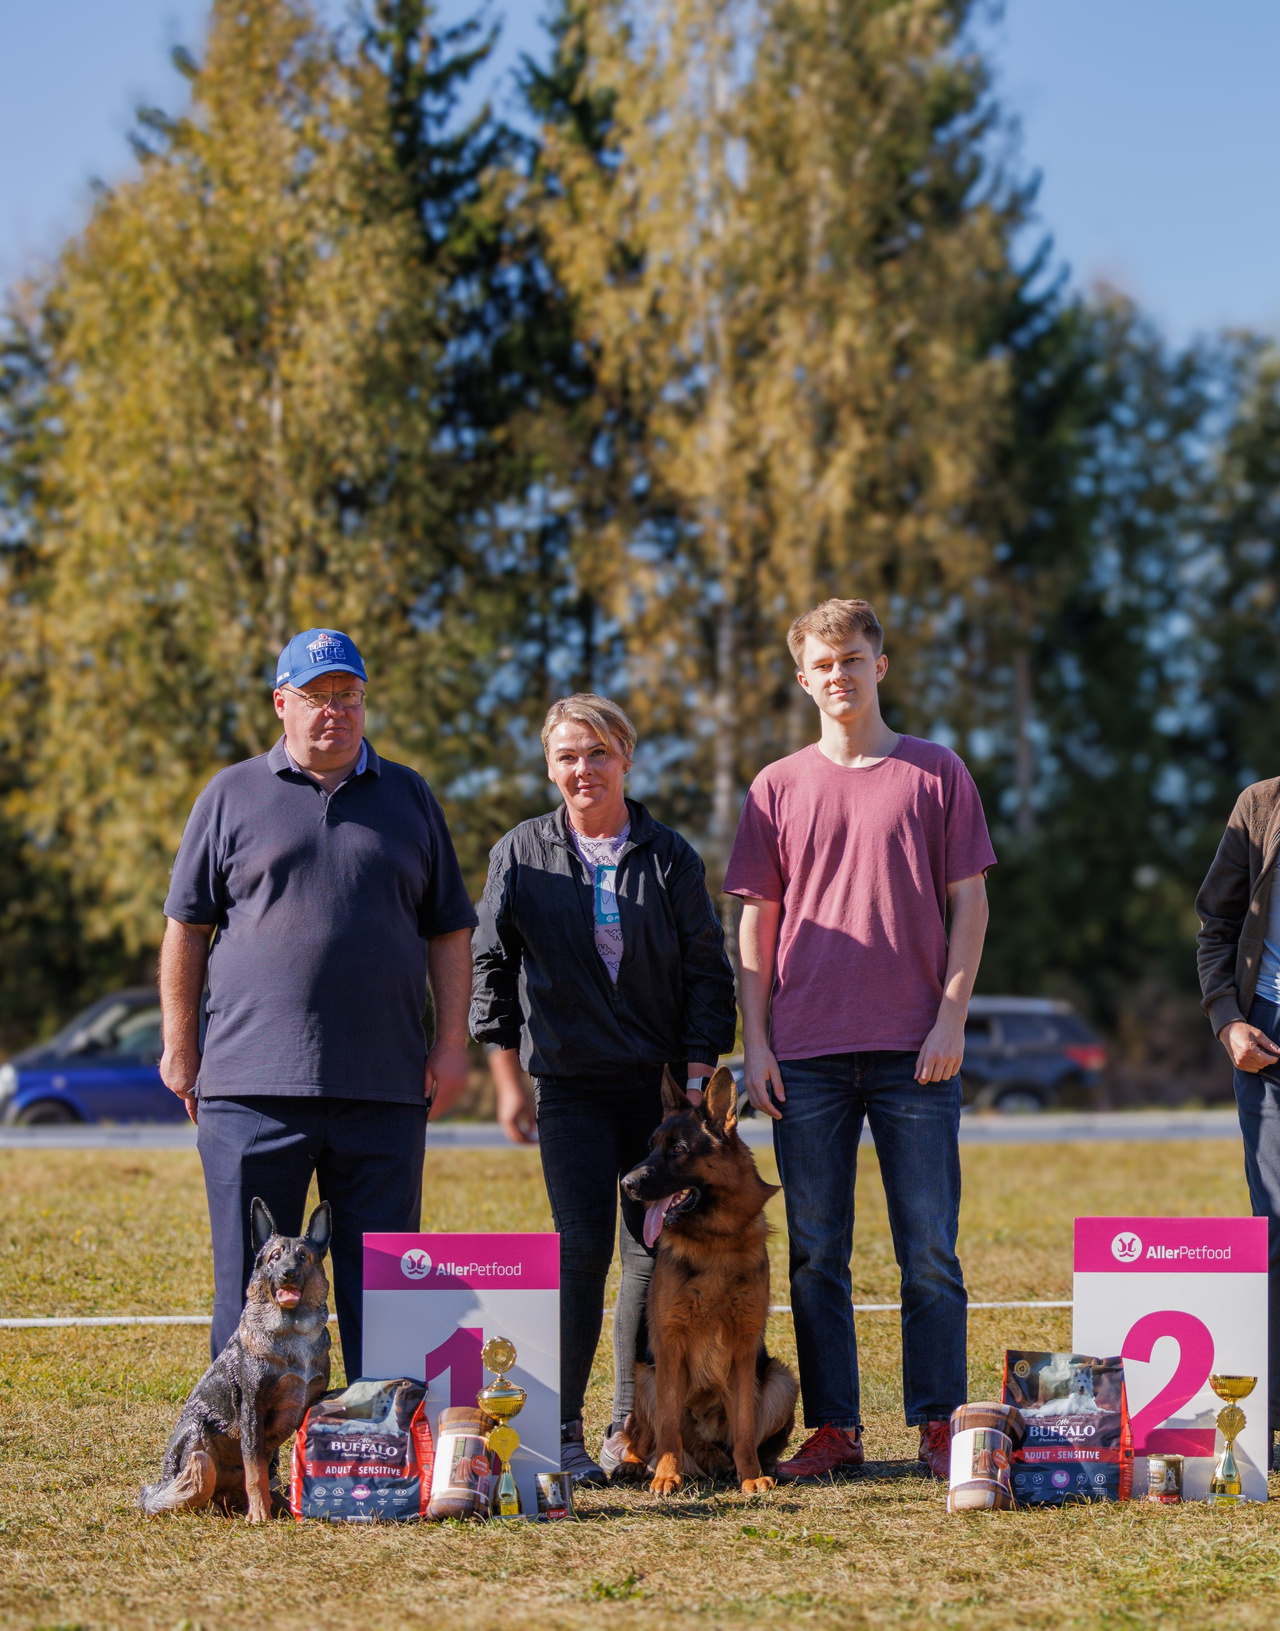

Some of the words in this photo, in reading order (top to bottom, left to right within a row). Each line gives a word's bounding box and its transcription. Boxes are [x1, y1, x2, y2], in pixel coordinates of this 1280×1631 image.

[1146, 1245, 1232, 1261] AllerPetfood
[435, 1262, 522, 1277] AllerPetfood
[1121, 1309, 1217, 1458] 2
[1029, 1425, 1096, 1437] BUFFALO
[331, 1441, 398, 1456] BUFFALO
[1024, 1451, 1051, 1460] ADULT
[1057, 1450, 1100, 1460] SENSITIVE
[325, 1465, 352, 1474] ADULT
[358, 1466, 401, 1476] SENSITIVE
